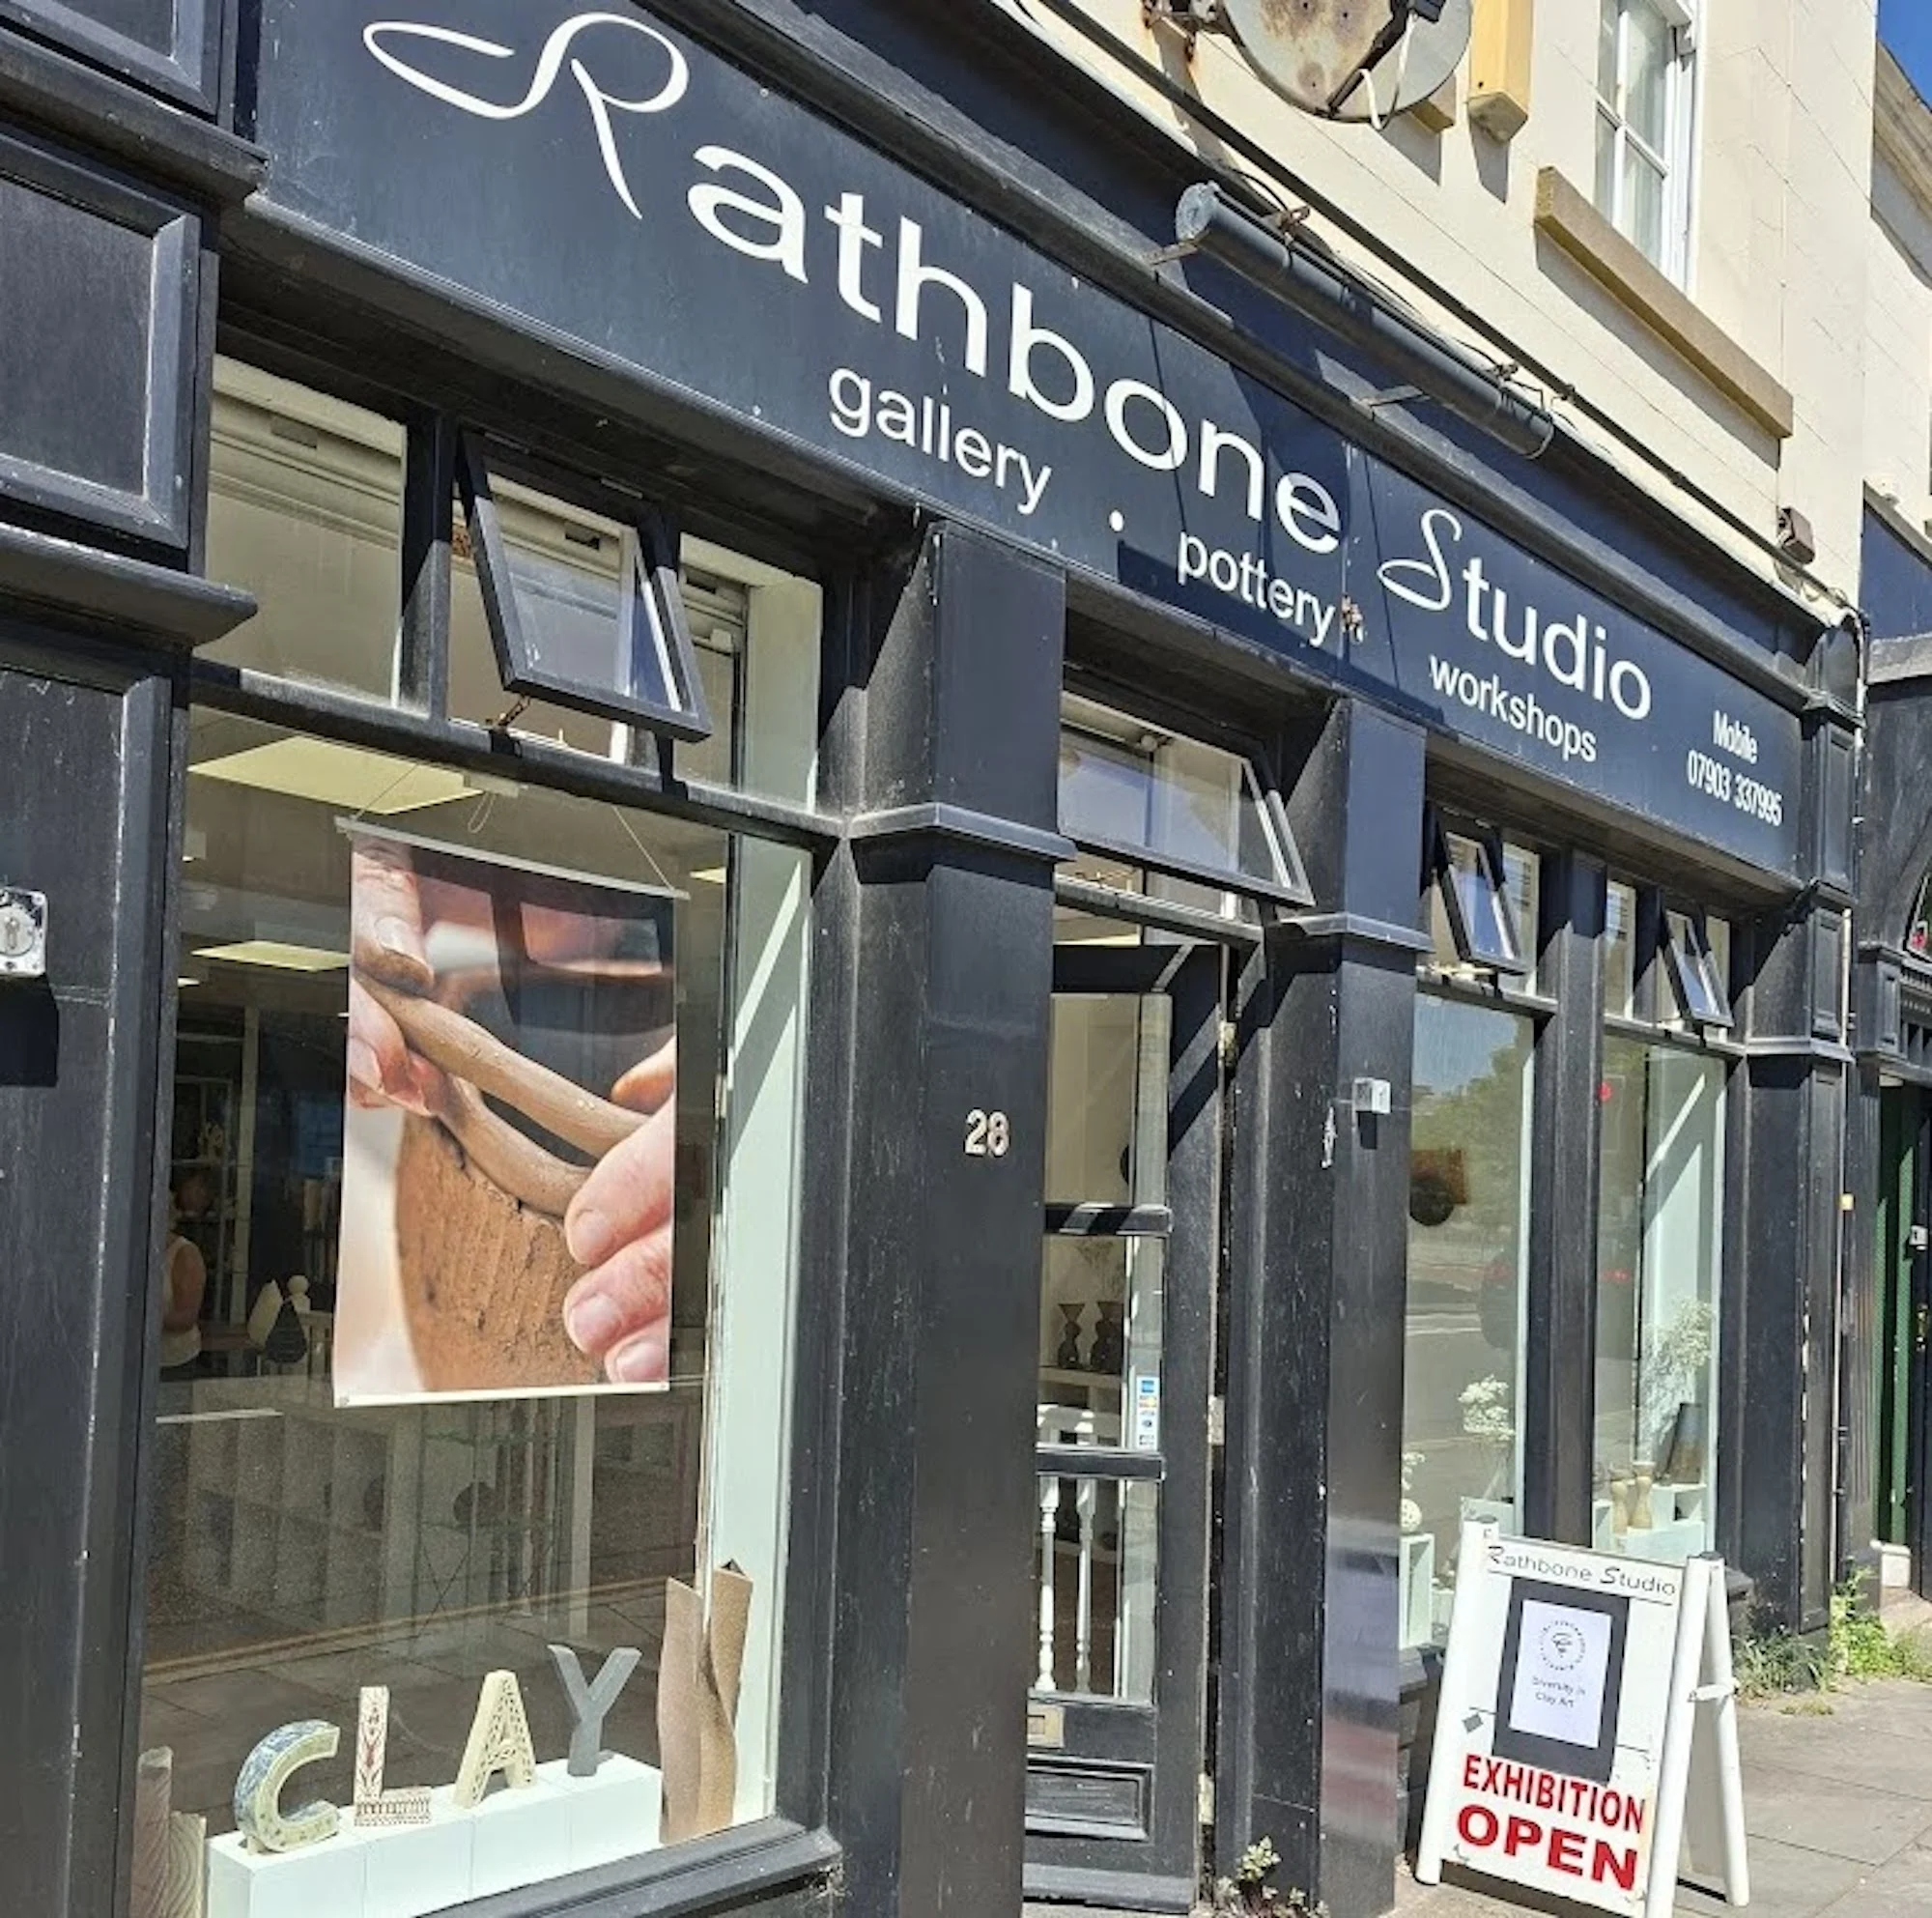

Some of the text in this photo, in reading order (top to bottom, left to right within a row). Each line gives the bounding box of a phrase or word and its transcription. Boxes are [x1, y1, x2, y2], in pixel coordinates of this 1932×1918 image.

[363, 13, 1652, 720] Rathbone Studio
[828, 366, 1597, 762] gallery pottery workshops
[1687, 749, 1732, 802] 07903
[1713, 709, 1758, 764] Mobile
[964, 1106, 1010, 1158] 28
[1488, 1545, 1676, 1596] Rathbone Studio
[235, 1644, 642, 1854] CLAY
[1463, 1754, 1647, 1835] EXHIBITION
[1457, 1804, 1638, 1892] OPEN
